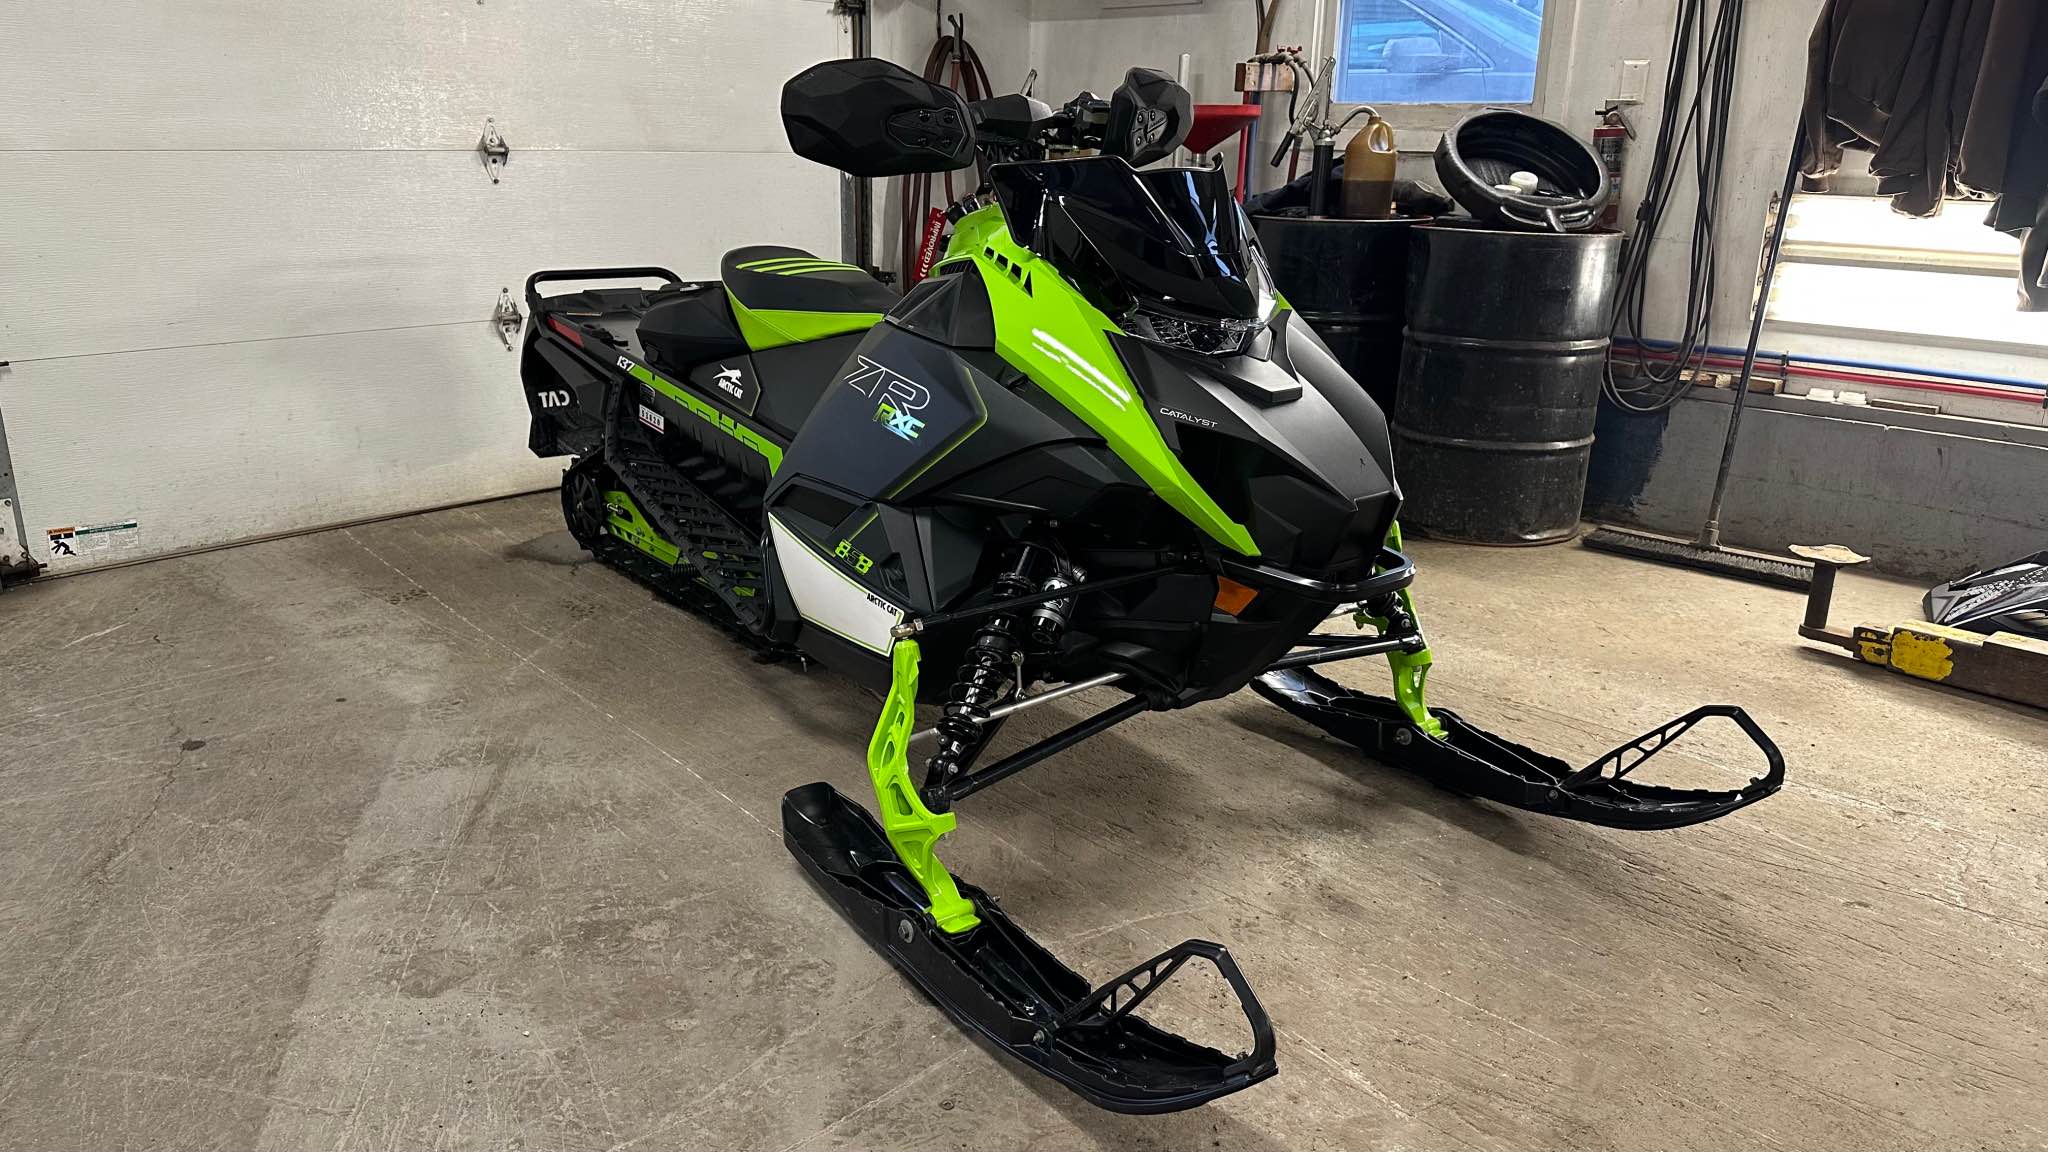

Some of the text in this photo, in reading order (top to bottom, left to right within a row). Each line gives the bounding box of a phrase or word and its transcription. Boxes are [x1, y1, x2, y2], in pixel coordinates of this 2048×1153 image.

[616, 355, 634, 372] 137
[718, 378, 735, 395] ARCTIC
[843, 355, 930, 417] ZR
[1160, 408, 1218, 427] CATALYST
[866, 593, 898, 616] ARCTIC CAT
